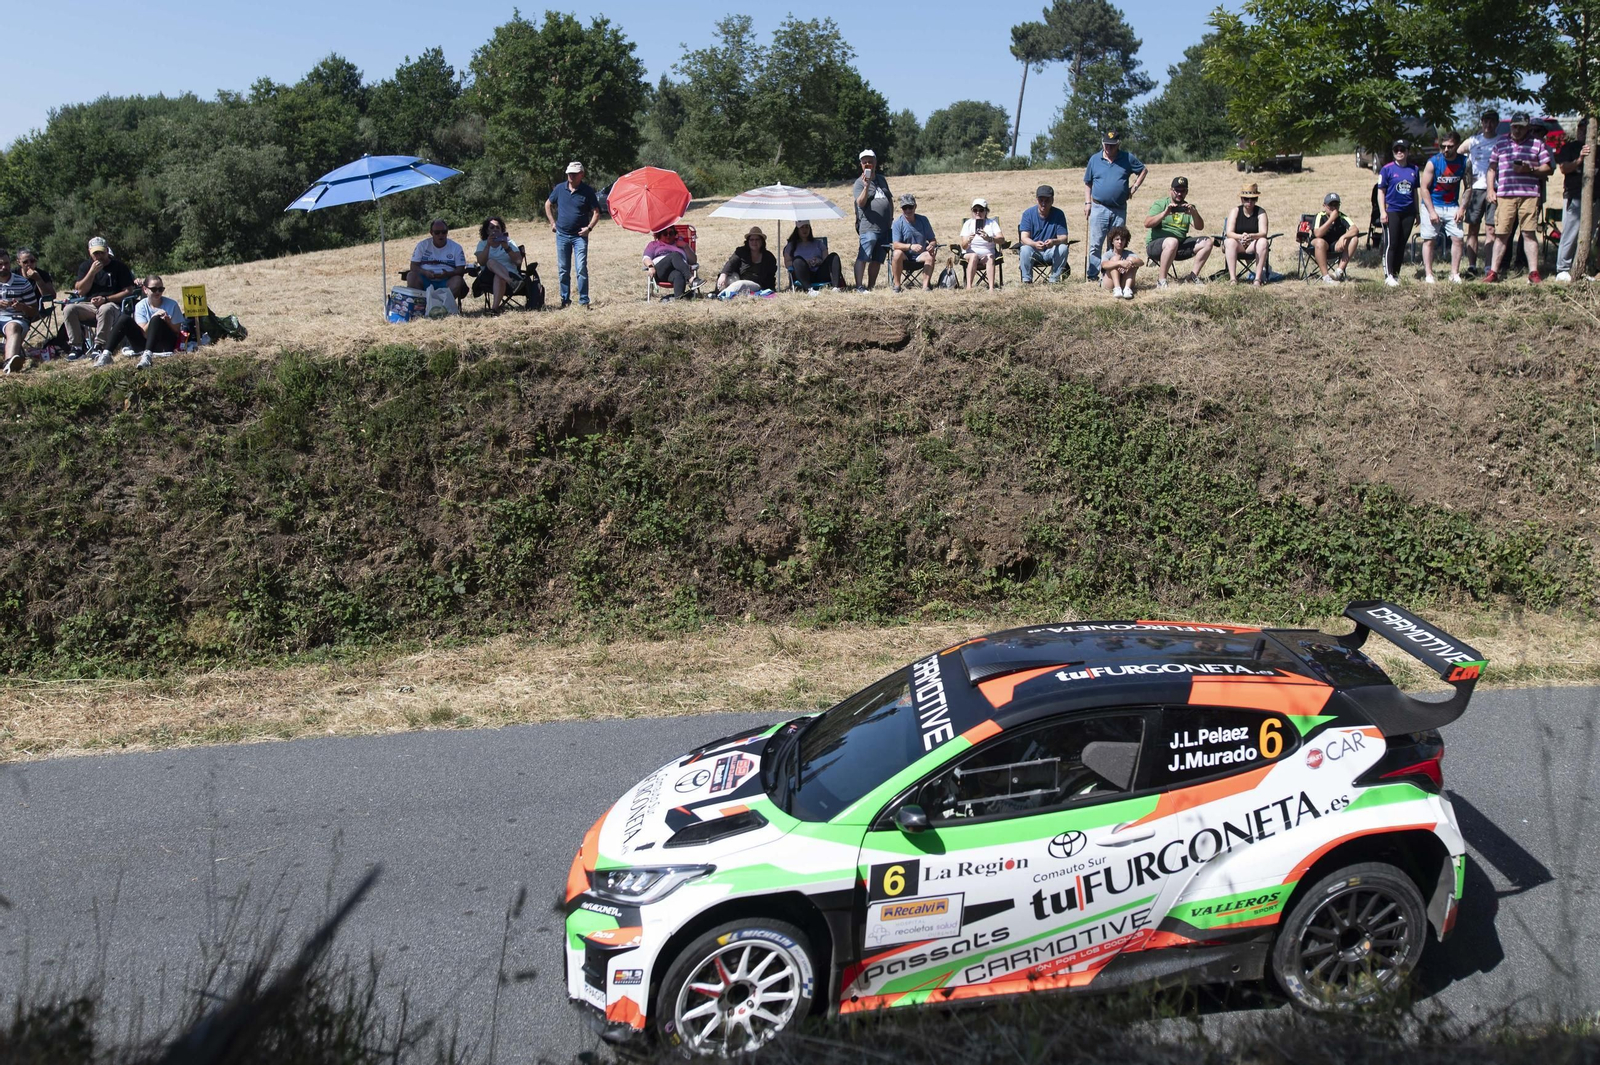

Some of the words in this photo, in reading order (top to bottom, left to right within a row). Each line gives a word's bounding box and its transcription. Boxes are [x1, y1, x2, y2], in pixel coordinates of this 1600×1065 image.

[1366, 607, 1476, 663] CARMOTIVE
[1169, 726, 1249, 749] J.L.Pelaez
[1259, 717, 1283, 759] 6
[1326, 731, 1366, 761] CAR
[1168, 745, 1258, 772] J.Murado
[883, 864, 906, 896] 6
[923, 866, 951, 882] La
[1033, 863, 1086, 884] Comauto
[1088, 855, 1107, 868] Sur
[893, 902, 936, 917] Recalvi
[1191, 891, 1281, 917] VALLEROS
[1254, 904, 1278, 915] SPORT
[895, 919, 926, 927] HOSPITAL
[895, 925, 934, 936] recoletas
[936, 920, 958, 931] salud
[741, 930, 794, 947] MICHELIN
[965, 908, 1152, 984] CARMOTIVE
[1056, 954, 1077, 966] POR
[1080, 946, 1100, 957] LOS
